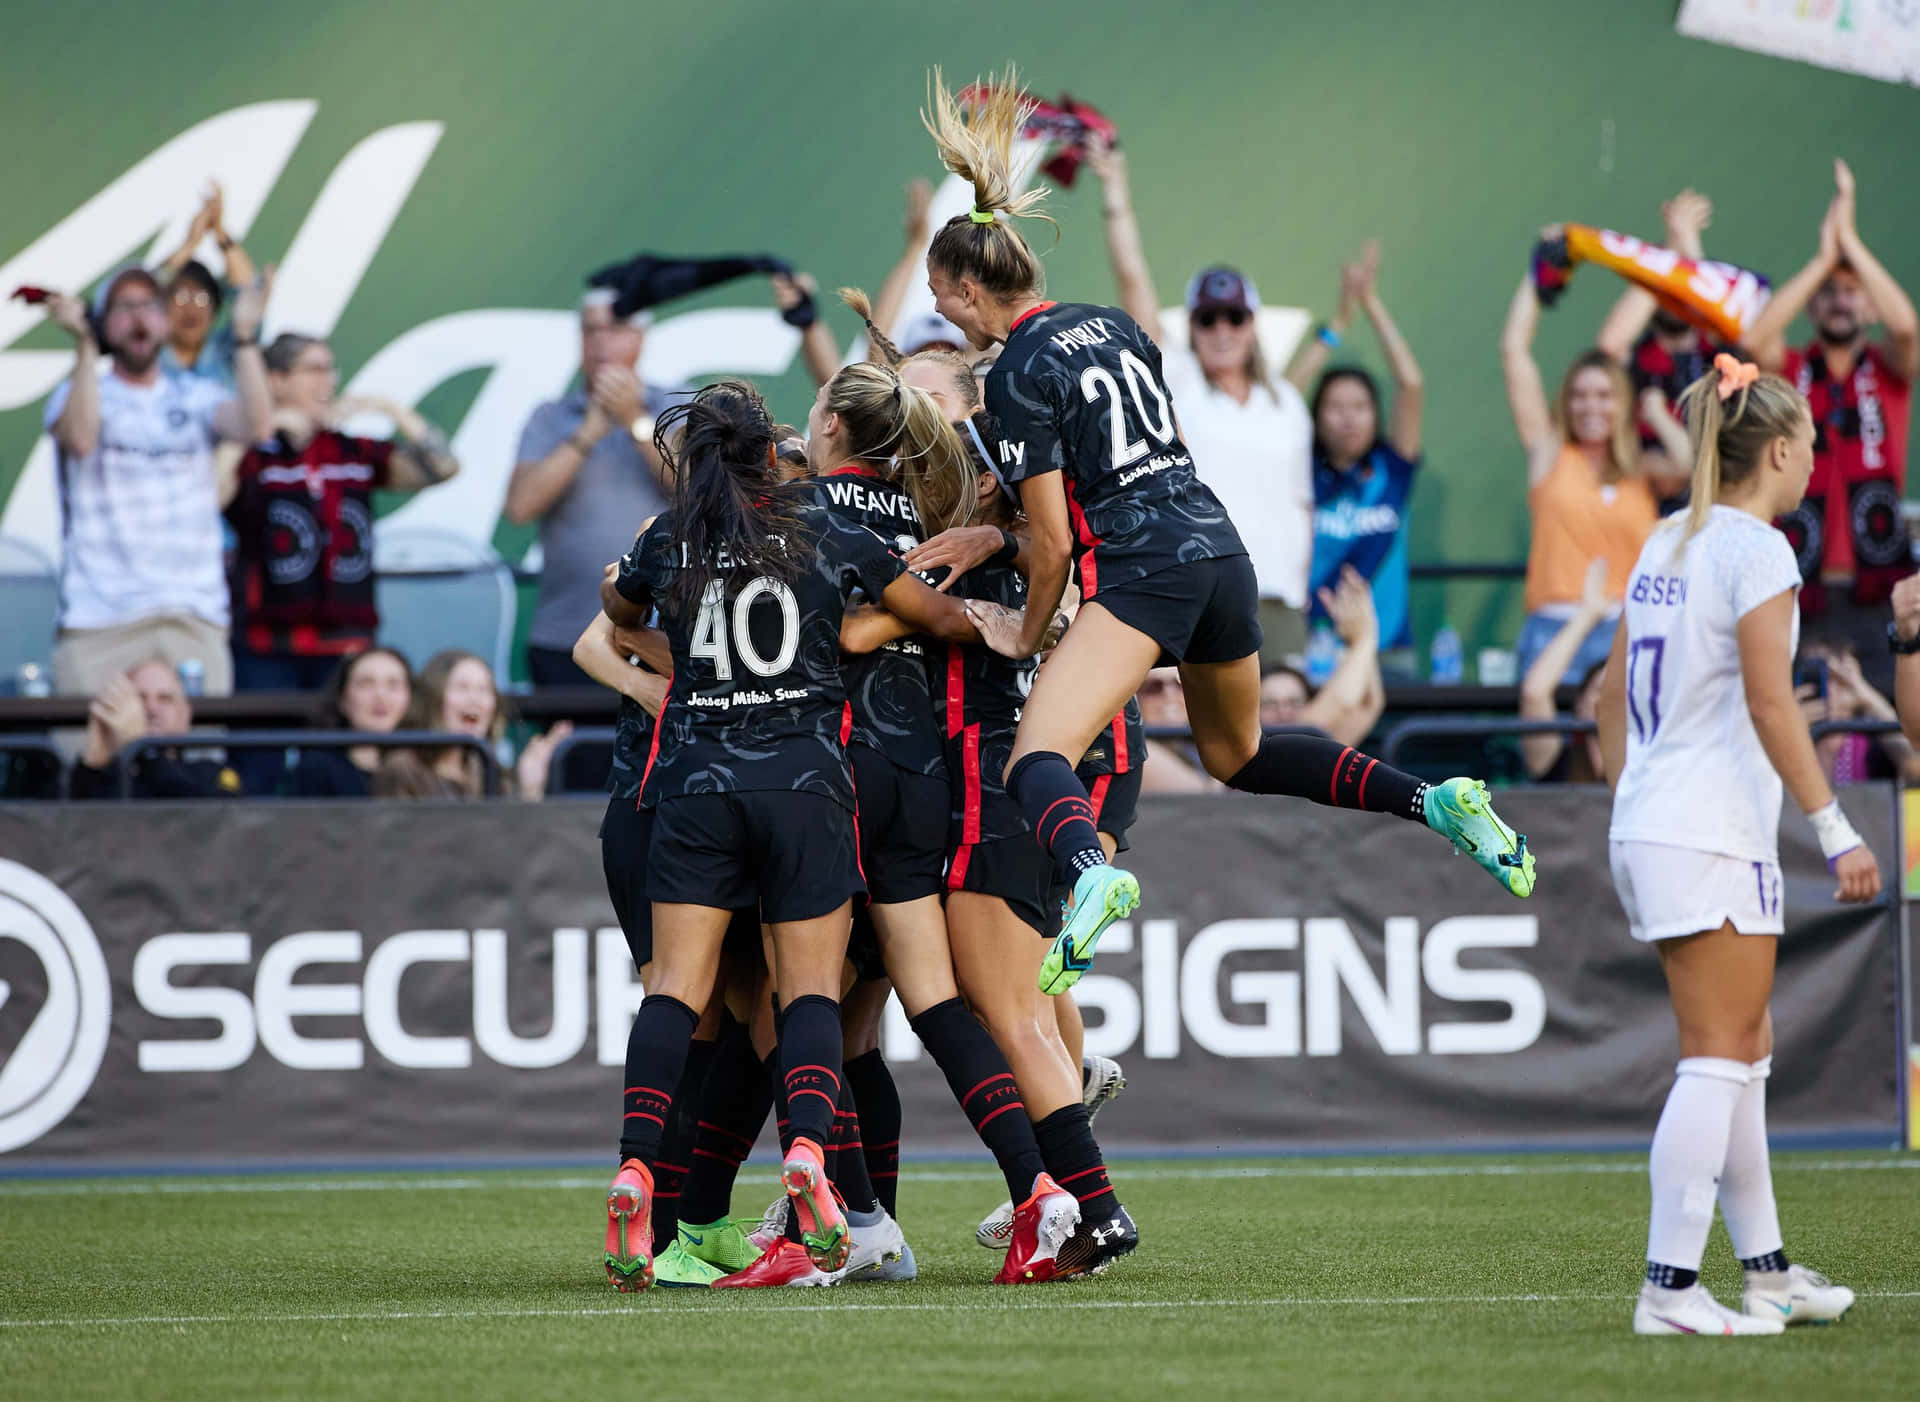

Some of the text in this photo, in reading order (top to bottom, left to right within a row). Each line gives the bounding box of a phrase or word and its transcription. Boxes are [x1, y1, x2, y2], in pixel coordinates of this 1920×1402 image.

[998, 439, 1025, 466] lly
[1080, 349, 1174, 470] 20
[689, 575, 800, 681] 40
[687, 687, 808, 710] Jersey Mike's Subs
[1628, 636, 1666, 746] 17
[1076, 915, 1547, 1059] SIGNS
